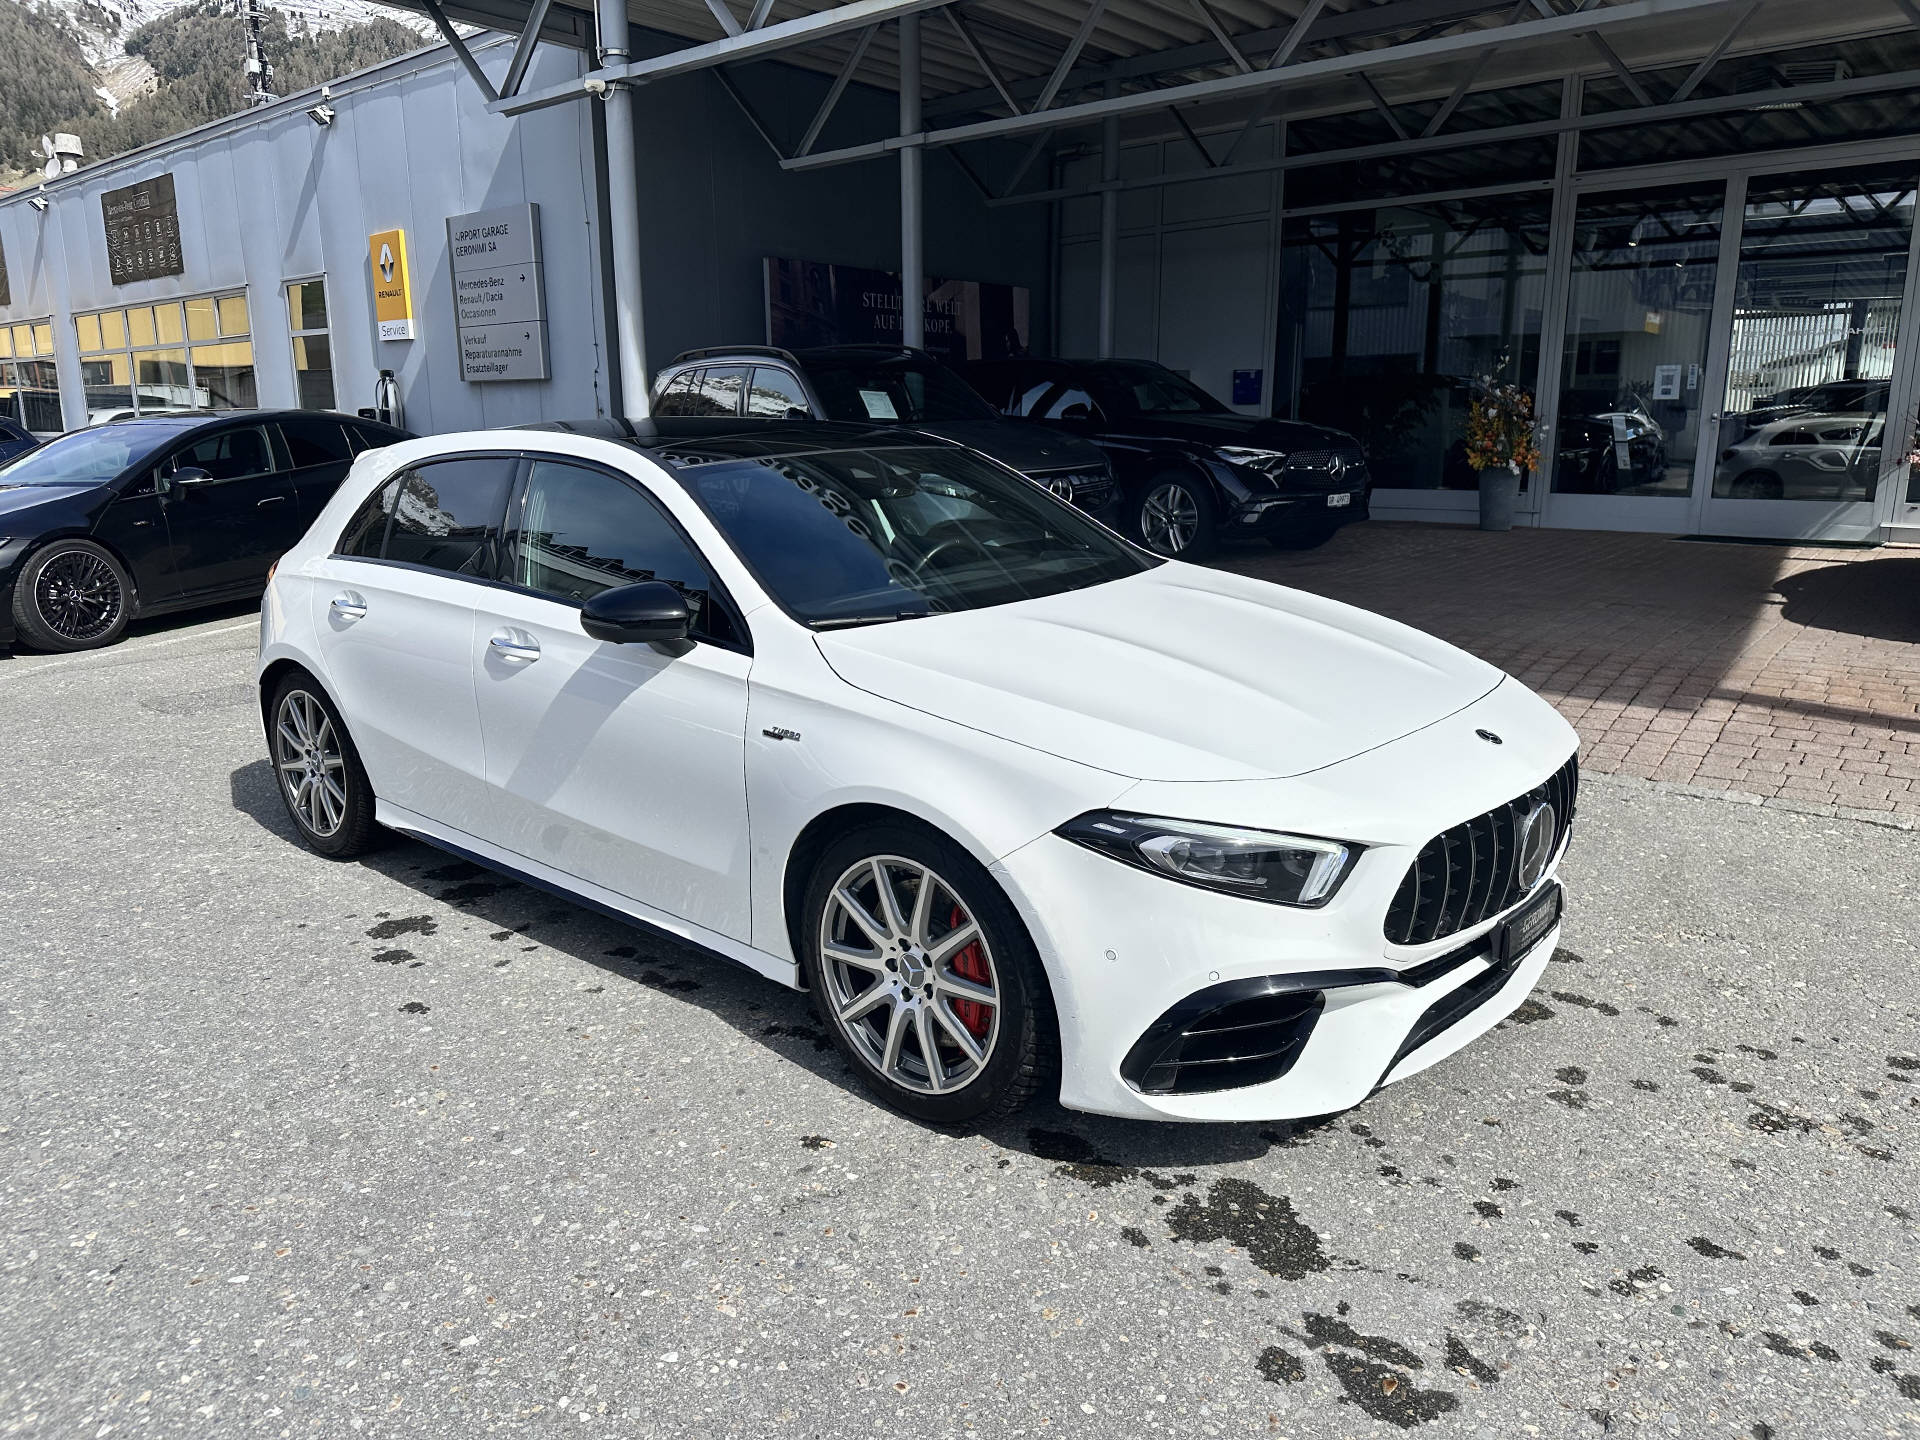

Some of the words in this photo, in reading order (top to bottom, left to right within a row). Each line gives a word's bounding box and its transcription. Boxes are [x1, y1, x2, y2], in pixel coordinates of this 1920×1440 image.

[454, 228, 481, 243] AIRPORT
[481, 223, 509, 238] GARAGE
[455, 243, 487, 257] GERONIMI
[487, 241, 497, 252] SA
[458, 276, 505, 291] Mercedes-Benz
[378, 289, 403, 299] RENAULT
[461, 306, 497, 320] Occasionen
[873, 314, 896, 330] AUF
[381, 325, 406, 337] Service
[463, 333, 488, 345] Verkauf
[464, 346, 523, 361] Reparaturannahme
[466, 362, 509, 376] Ersatzteillager
[771, 726, 801, 739] TURBO
